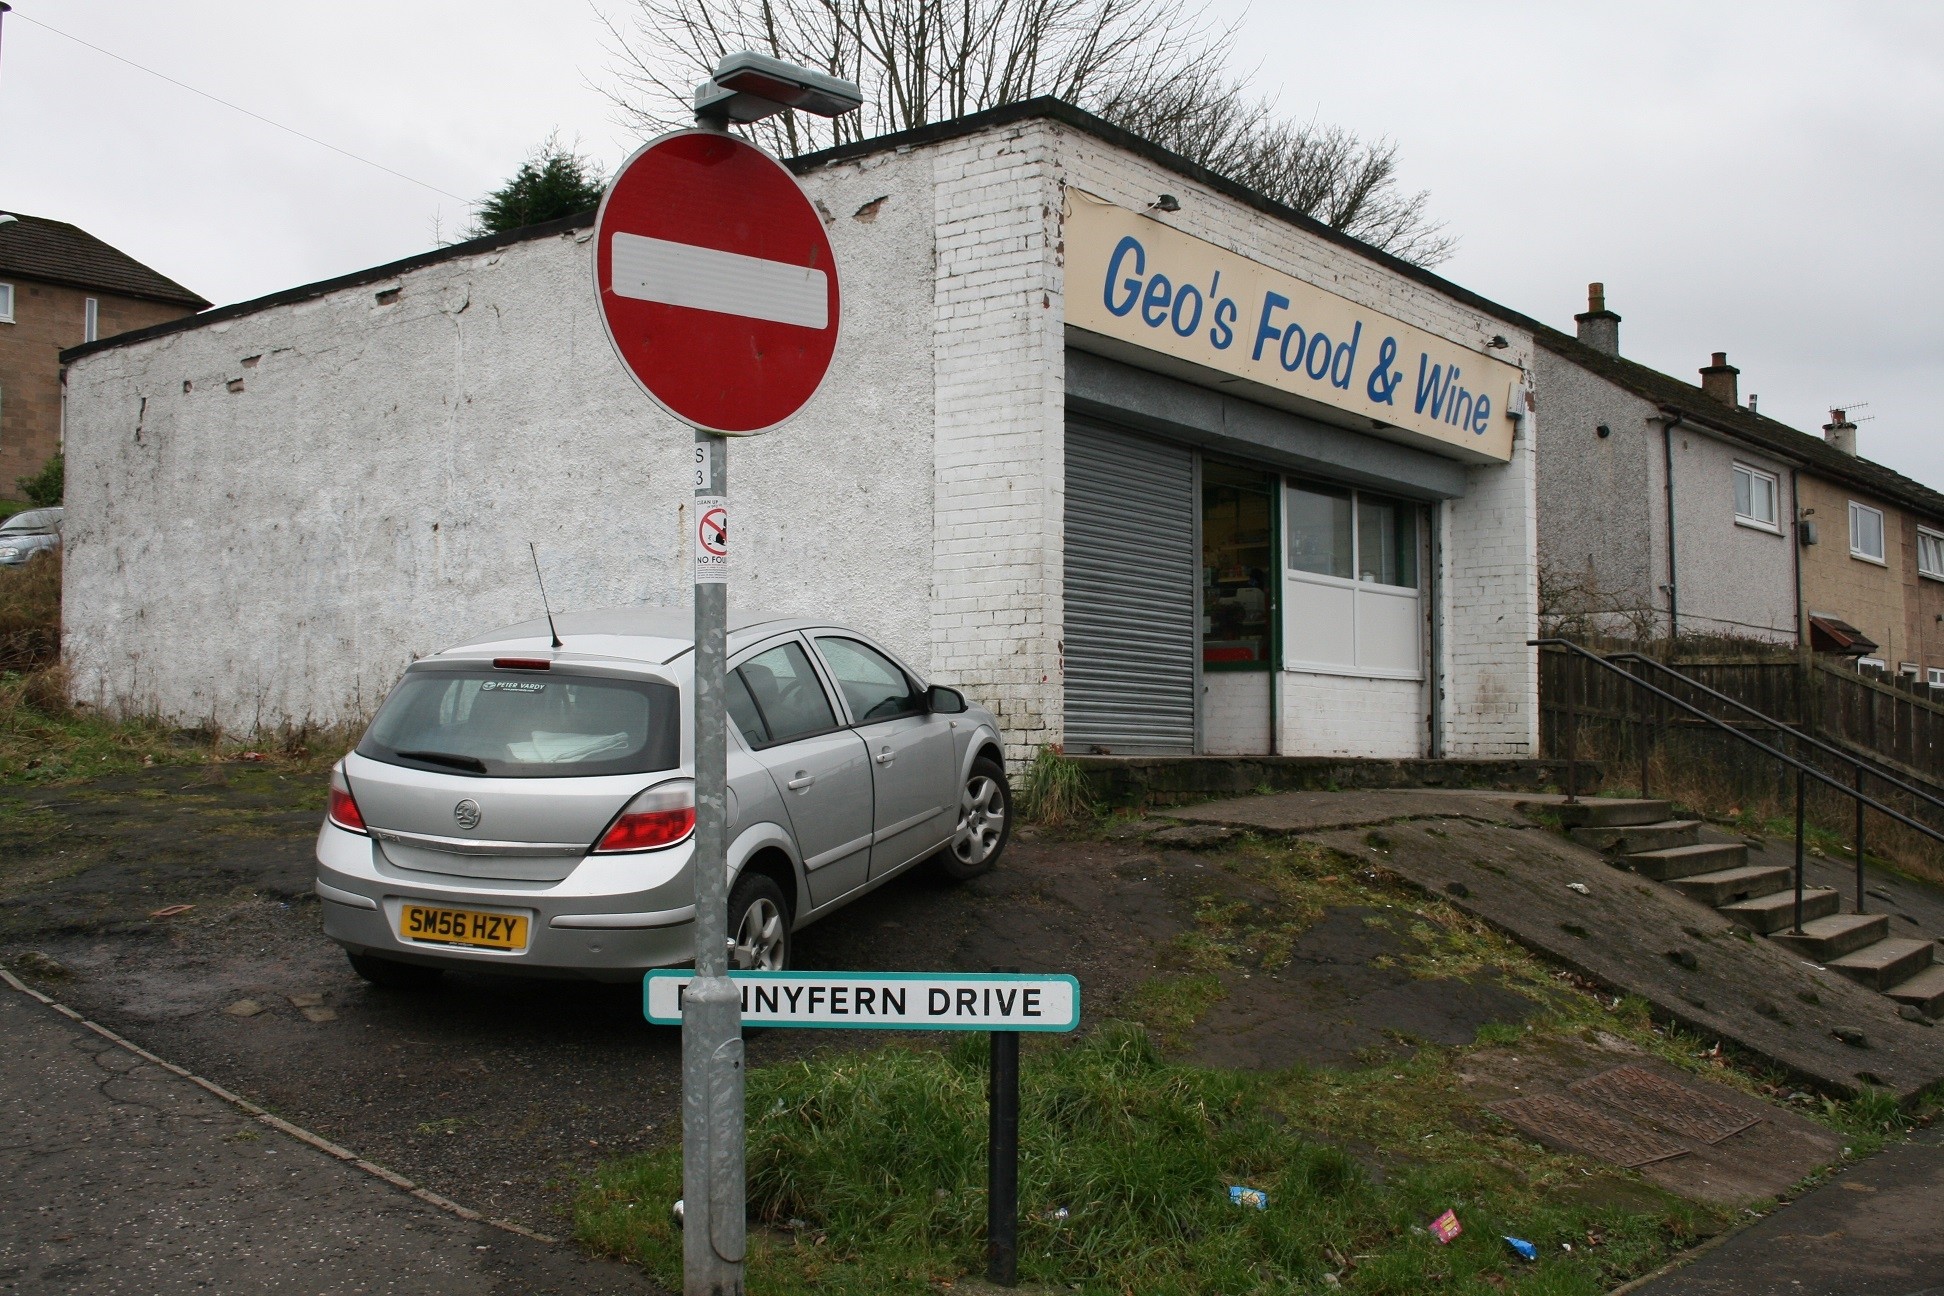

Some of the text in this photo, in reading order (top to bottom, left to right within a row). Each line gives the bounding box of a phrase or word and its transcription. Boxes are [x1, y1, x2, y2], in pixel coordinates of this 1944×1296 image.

[1103, 235, 1491, 436] Geo's Food & Wine
[695, 448, 704, 463] S
[696, 470, 703, 485] 3
[697, 556, 709, 564] NO
[520, 682, 546, 691] VARDY
[409, 908, 517, 942] SM56 HZY
[678, 984, 1042, 1017] NYFERN DRIVE
